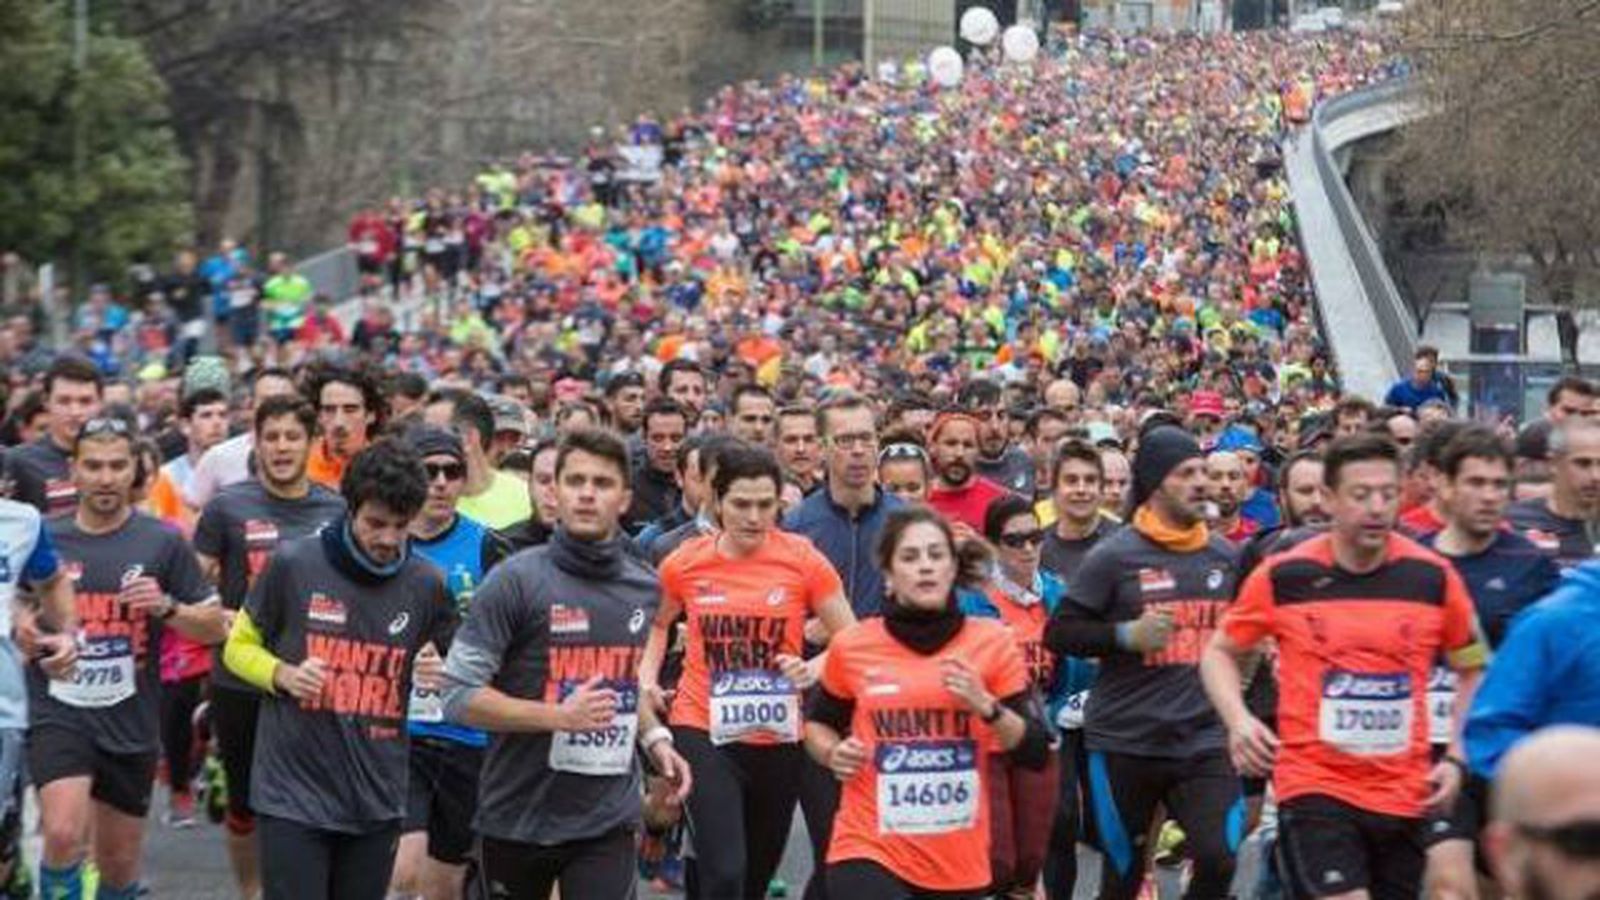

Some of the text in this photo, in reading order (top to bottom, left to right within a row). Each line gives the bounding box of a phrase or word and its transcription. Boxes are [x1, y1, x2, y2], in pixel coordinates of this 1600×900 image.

[698, 614, 788, 643] WANT IT
[306, 632, 388, 703] WANT
[548, 644, 631, 681] WANT
[720, 702, 788, 724] 11800
[870, 708, 948, 740] WANT
[905, 747, 956, 769] asics
[888, 780, 970, 807] 14606
